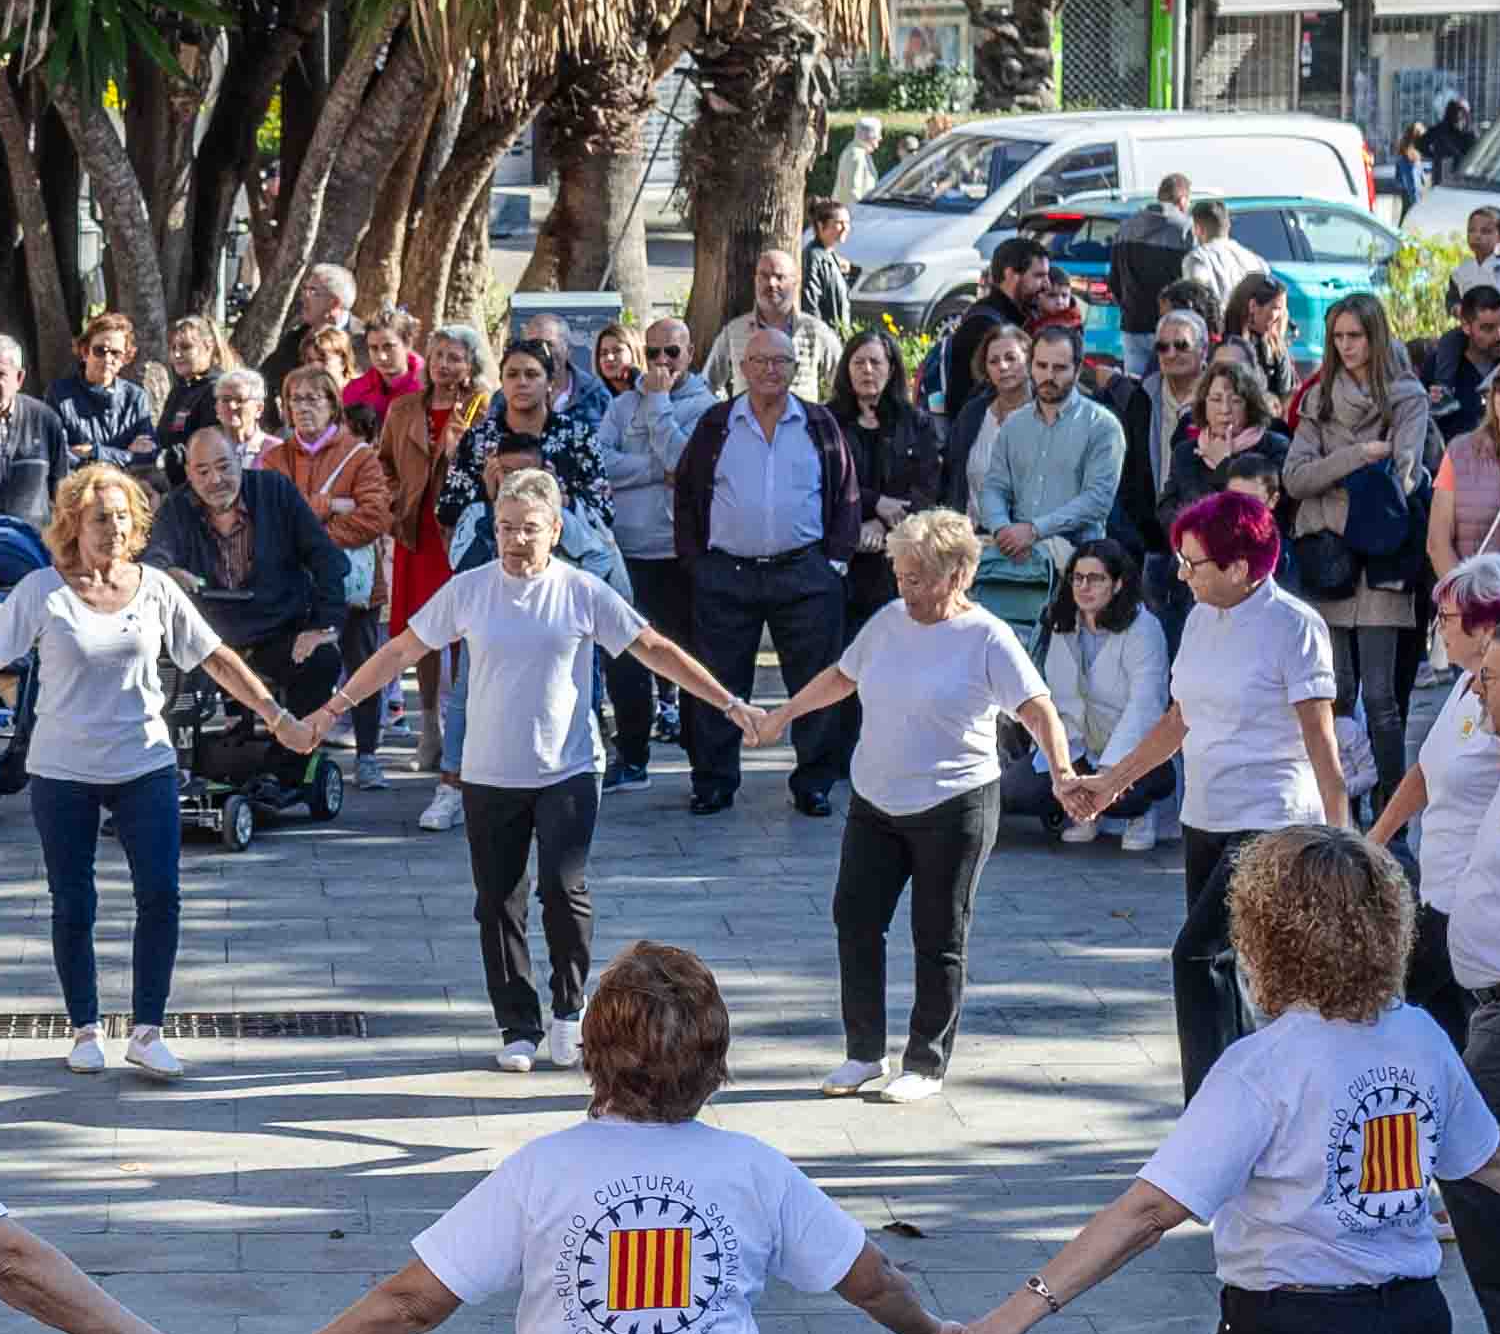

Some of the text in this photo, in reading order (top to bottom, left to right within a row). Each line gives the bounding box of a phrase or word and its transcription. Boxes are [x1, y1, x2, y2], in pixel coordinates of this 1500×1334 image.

[1347, 1066, 1417, 1100] CULTURAL
[594, 1175, 697, 1205] CULTURAL
[704, 1202, 739, 1314] SARDANISTA
